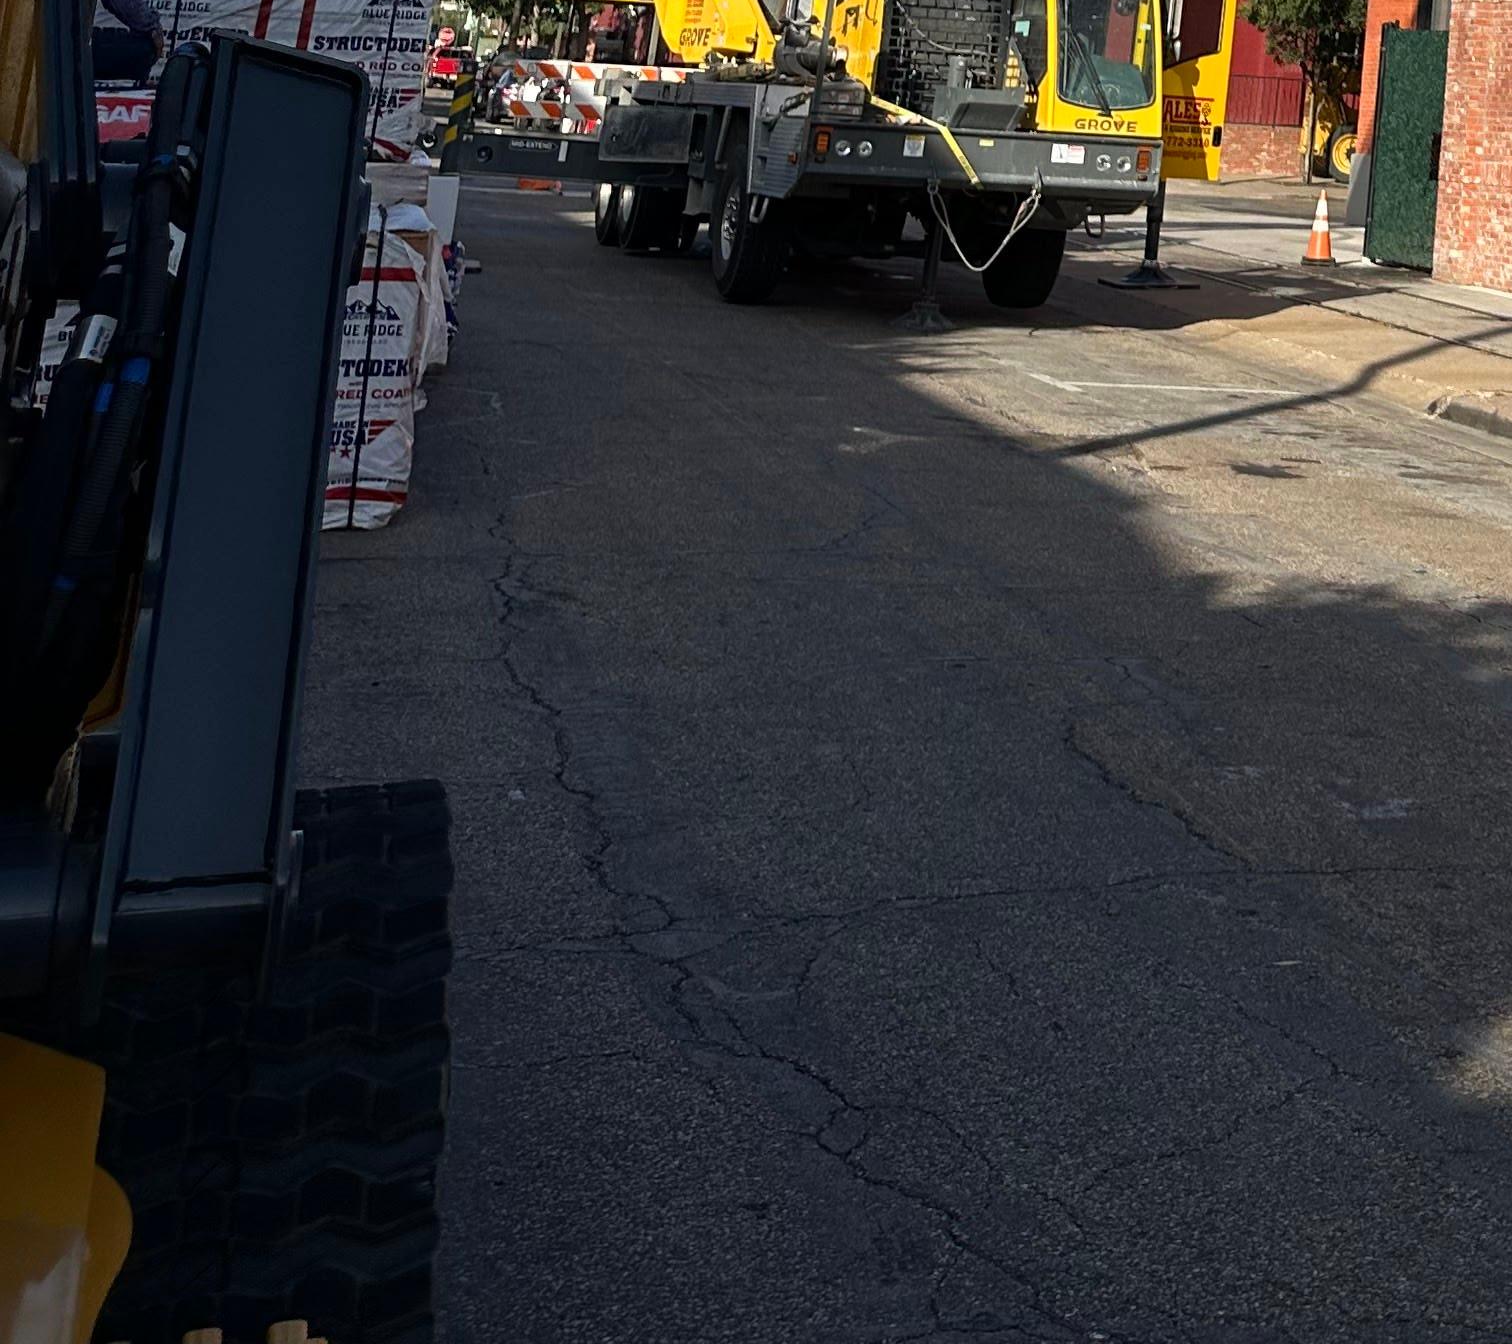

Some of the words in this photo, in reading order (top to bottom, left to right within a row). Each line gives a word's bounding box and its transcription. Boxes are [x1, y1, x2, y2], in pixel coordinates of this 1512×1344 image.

[146, 0, 171, 12] LUE
[361, 9, 389, 20] BLUE
[679, 27, 712, 47] GROVE
[1074, 117, 1138, 133] GROVE
[330, 430, 369, 446] USA
